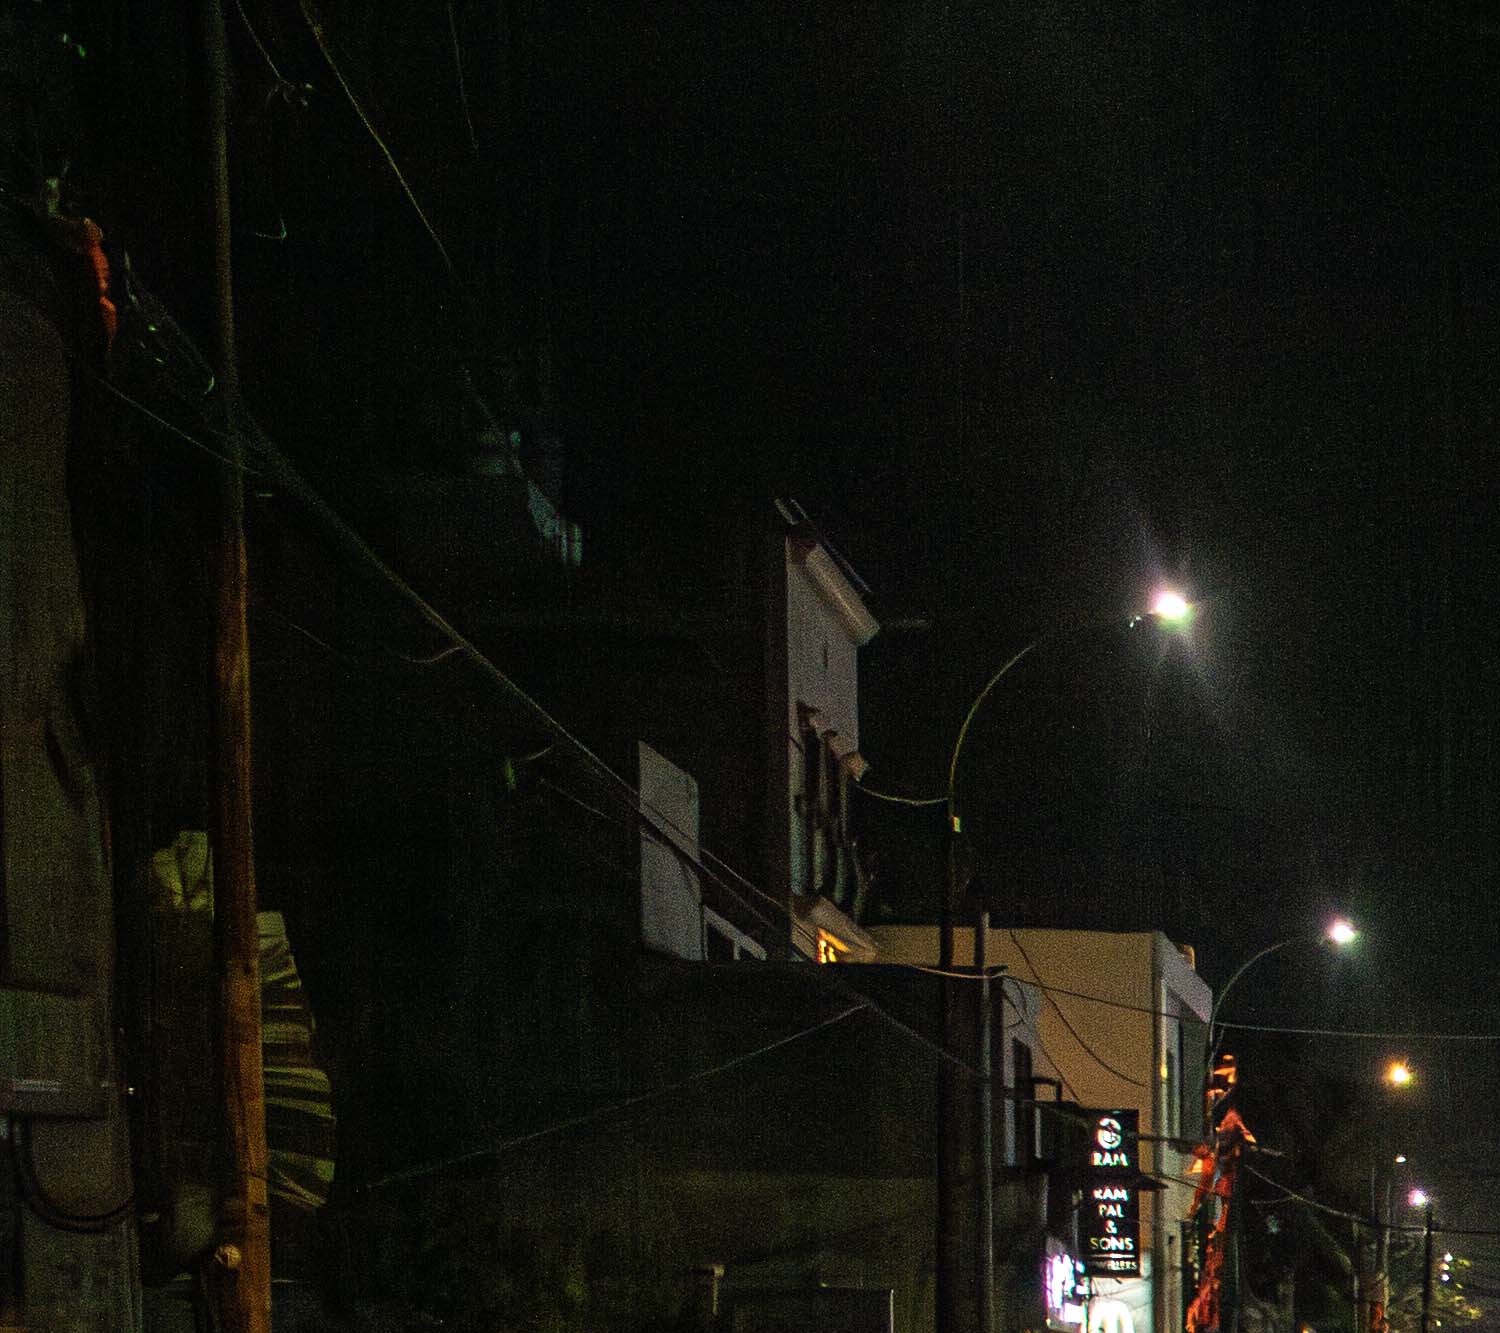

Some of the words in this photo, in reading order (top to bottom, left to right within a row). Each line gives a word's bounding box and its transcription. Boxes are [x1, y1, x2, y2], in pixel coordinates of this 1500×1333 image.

[1092, 1152, 1129, 1167] RAM
[1099, 1204, 1124, 1218] PAL
[1106, 1220, 1117, 1234] &
[1090, 1237, 1134, 1251] SONS
